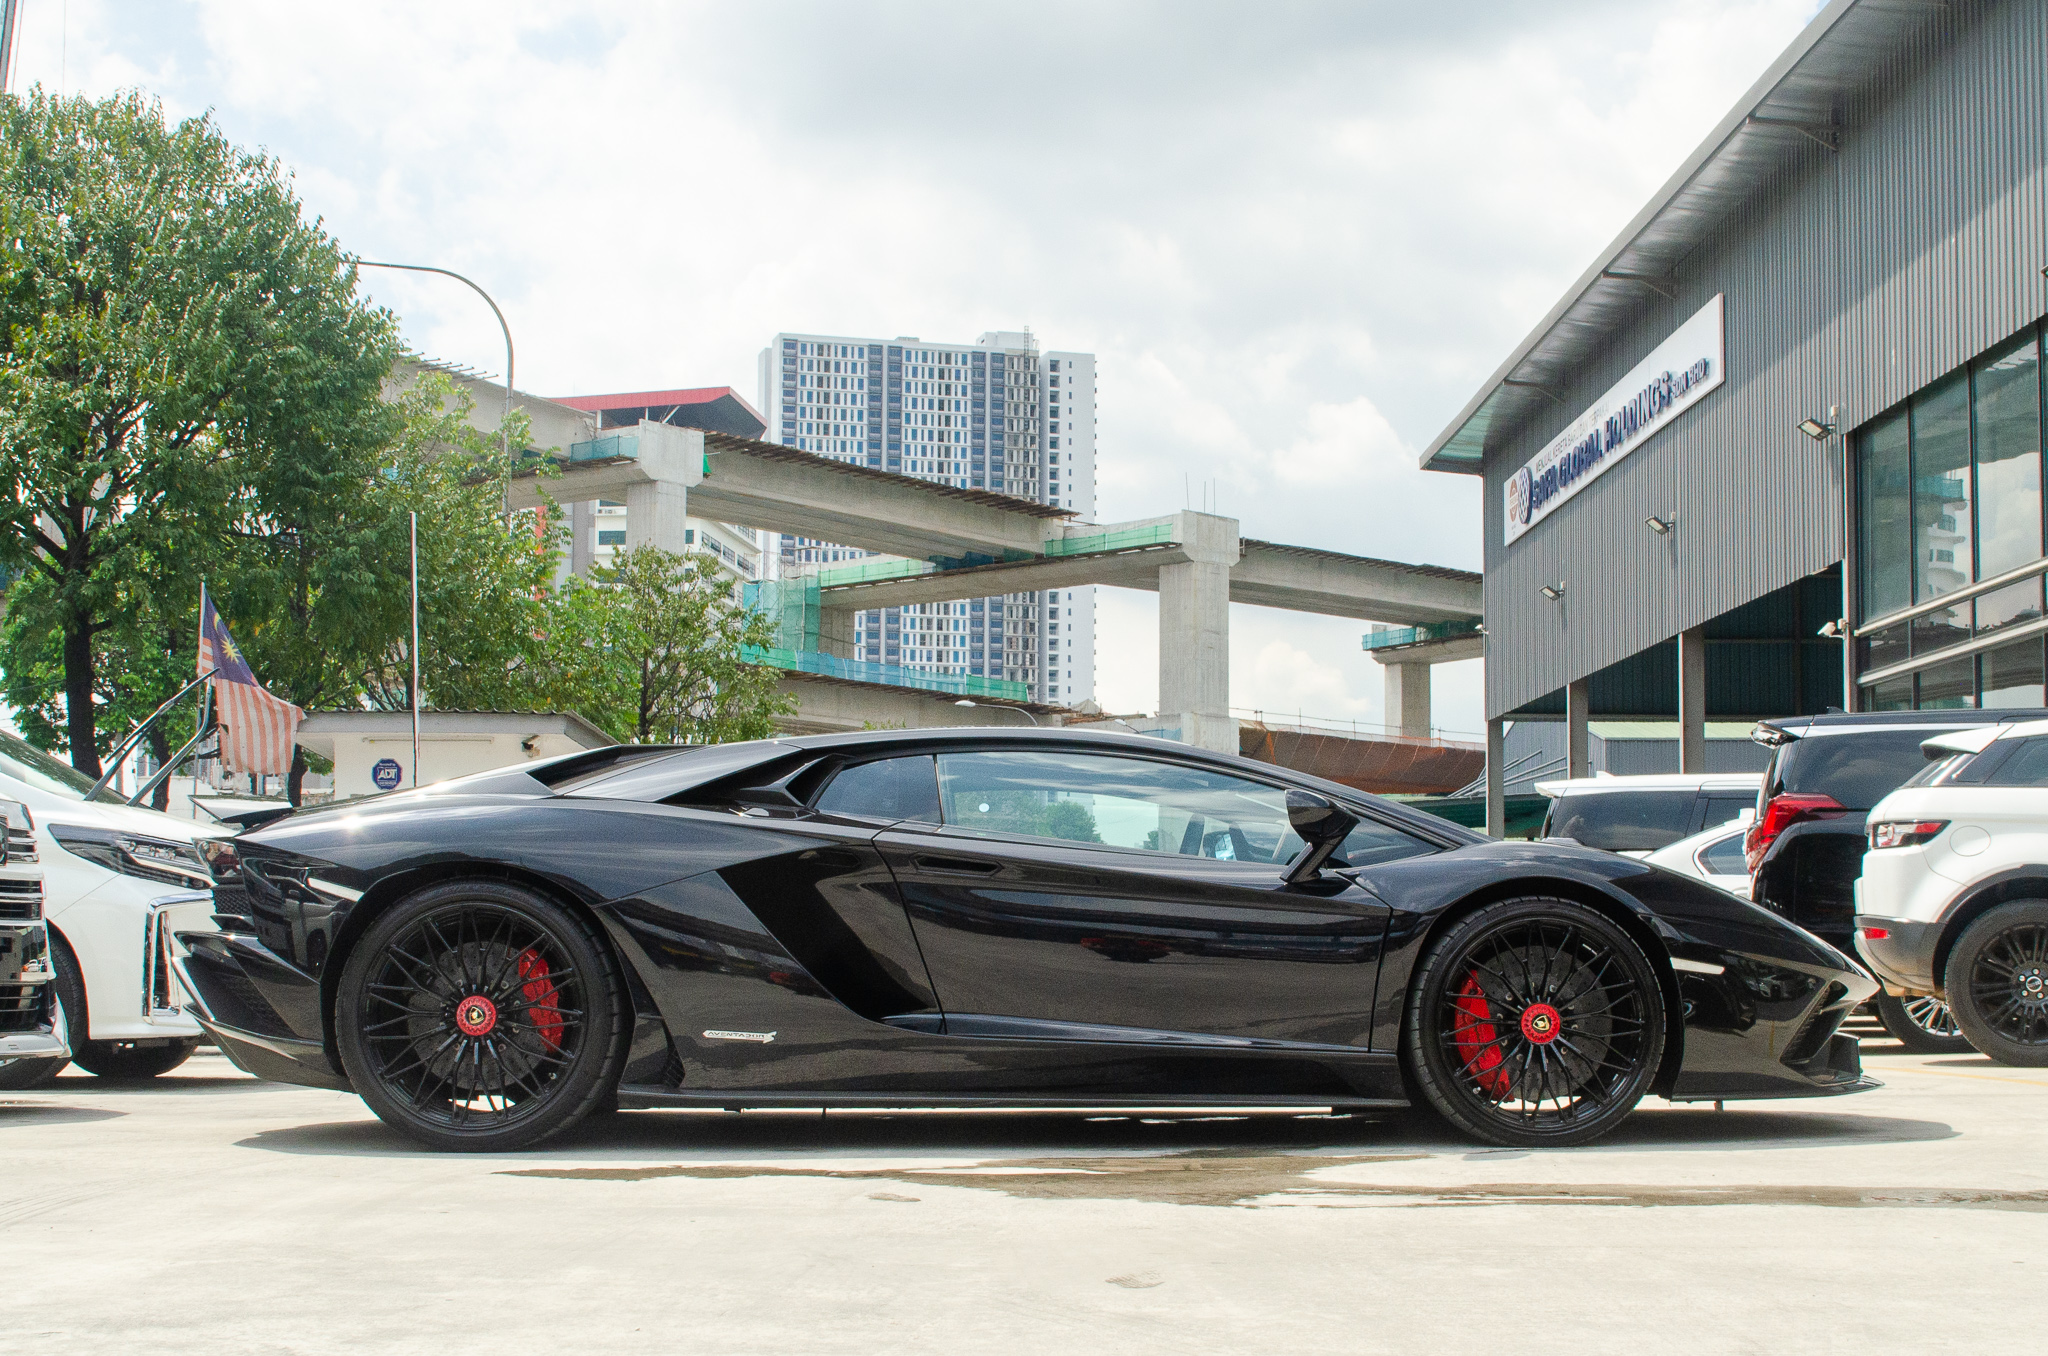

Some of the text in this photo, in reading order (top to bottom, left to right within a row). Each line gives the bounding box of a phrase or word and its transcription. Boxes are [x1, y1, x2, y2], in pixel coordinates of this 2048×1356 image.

[1559, 429, 1603, 488] GLOBAL
[1603, 371, 1670, 453] HOLDINGS
[1671, 371, 1689, 398] SDN
[1689, 358, 1709, 387] BHD
[378, 768, 397, 779] ADT
[707, 1031, 765, 1039] AVENTADOR
